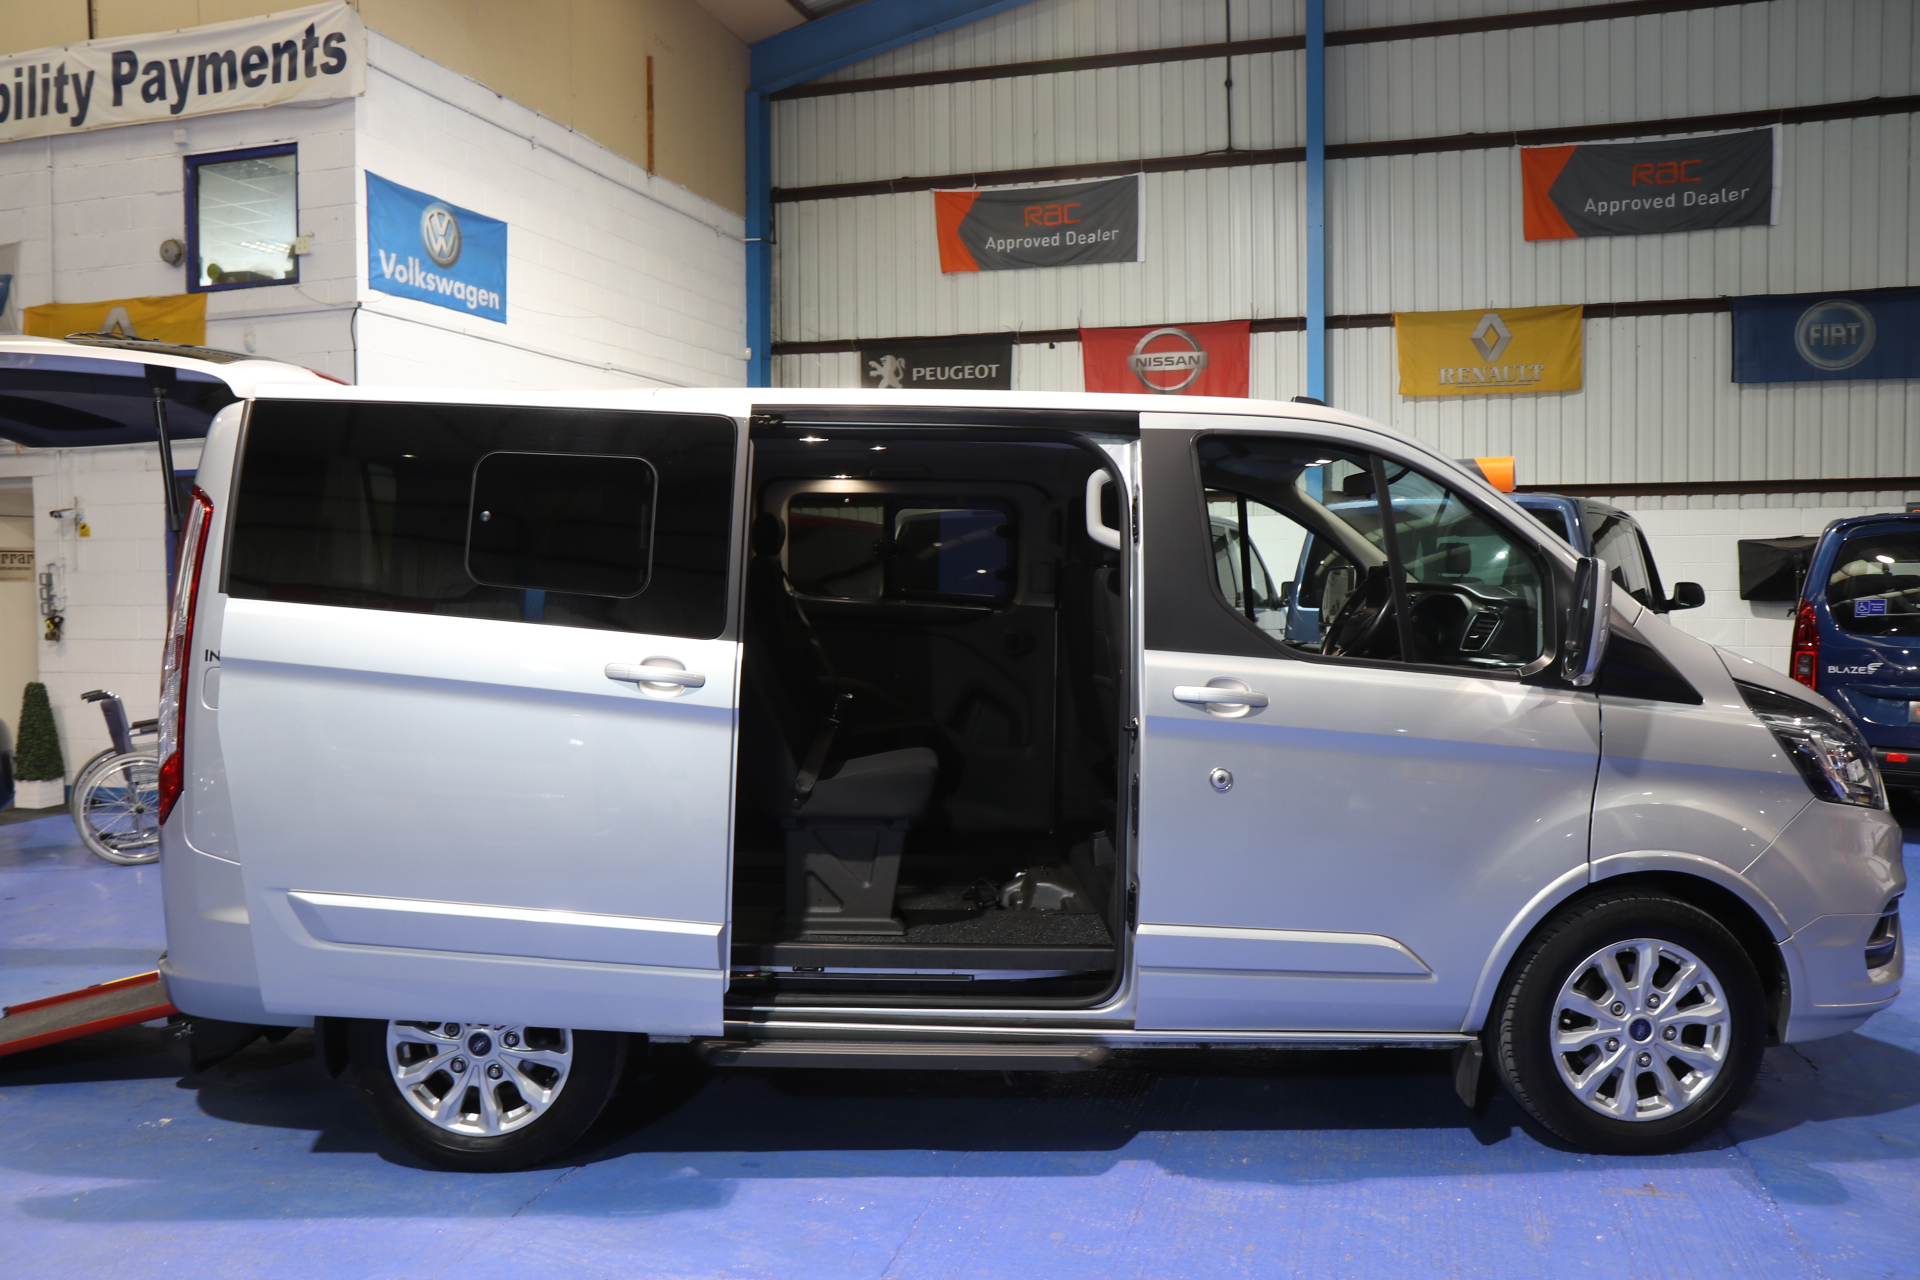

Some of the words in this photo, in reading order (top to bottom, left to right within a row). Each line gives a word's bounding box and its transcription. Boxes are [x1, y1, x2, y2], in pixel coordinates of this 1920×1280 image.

[112, 22, 347, 115] Payments
[1584, 193, 1675, 216] Approved
[1683, 188, 1750, 207] Dealer
[985, 232, 1060, 252] Approved
[1066, 229, 1119, 245] Dealer
[379, 248, 500, 310] Volkswagen
[1809, 322, 1861, 346] FIAT
[912, 363, 1000, 381] PEUGEOT
[1135, 355, 1200, 368] NISSAN
[1438, 364, 1544, 385] RENAULT
